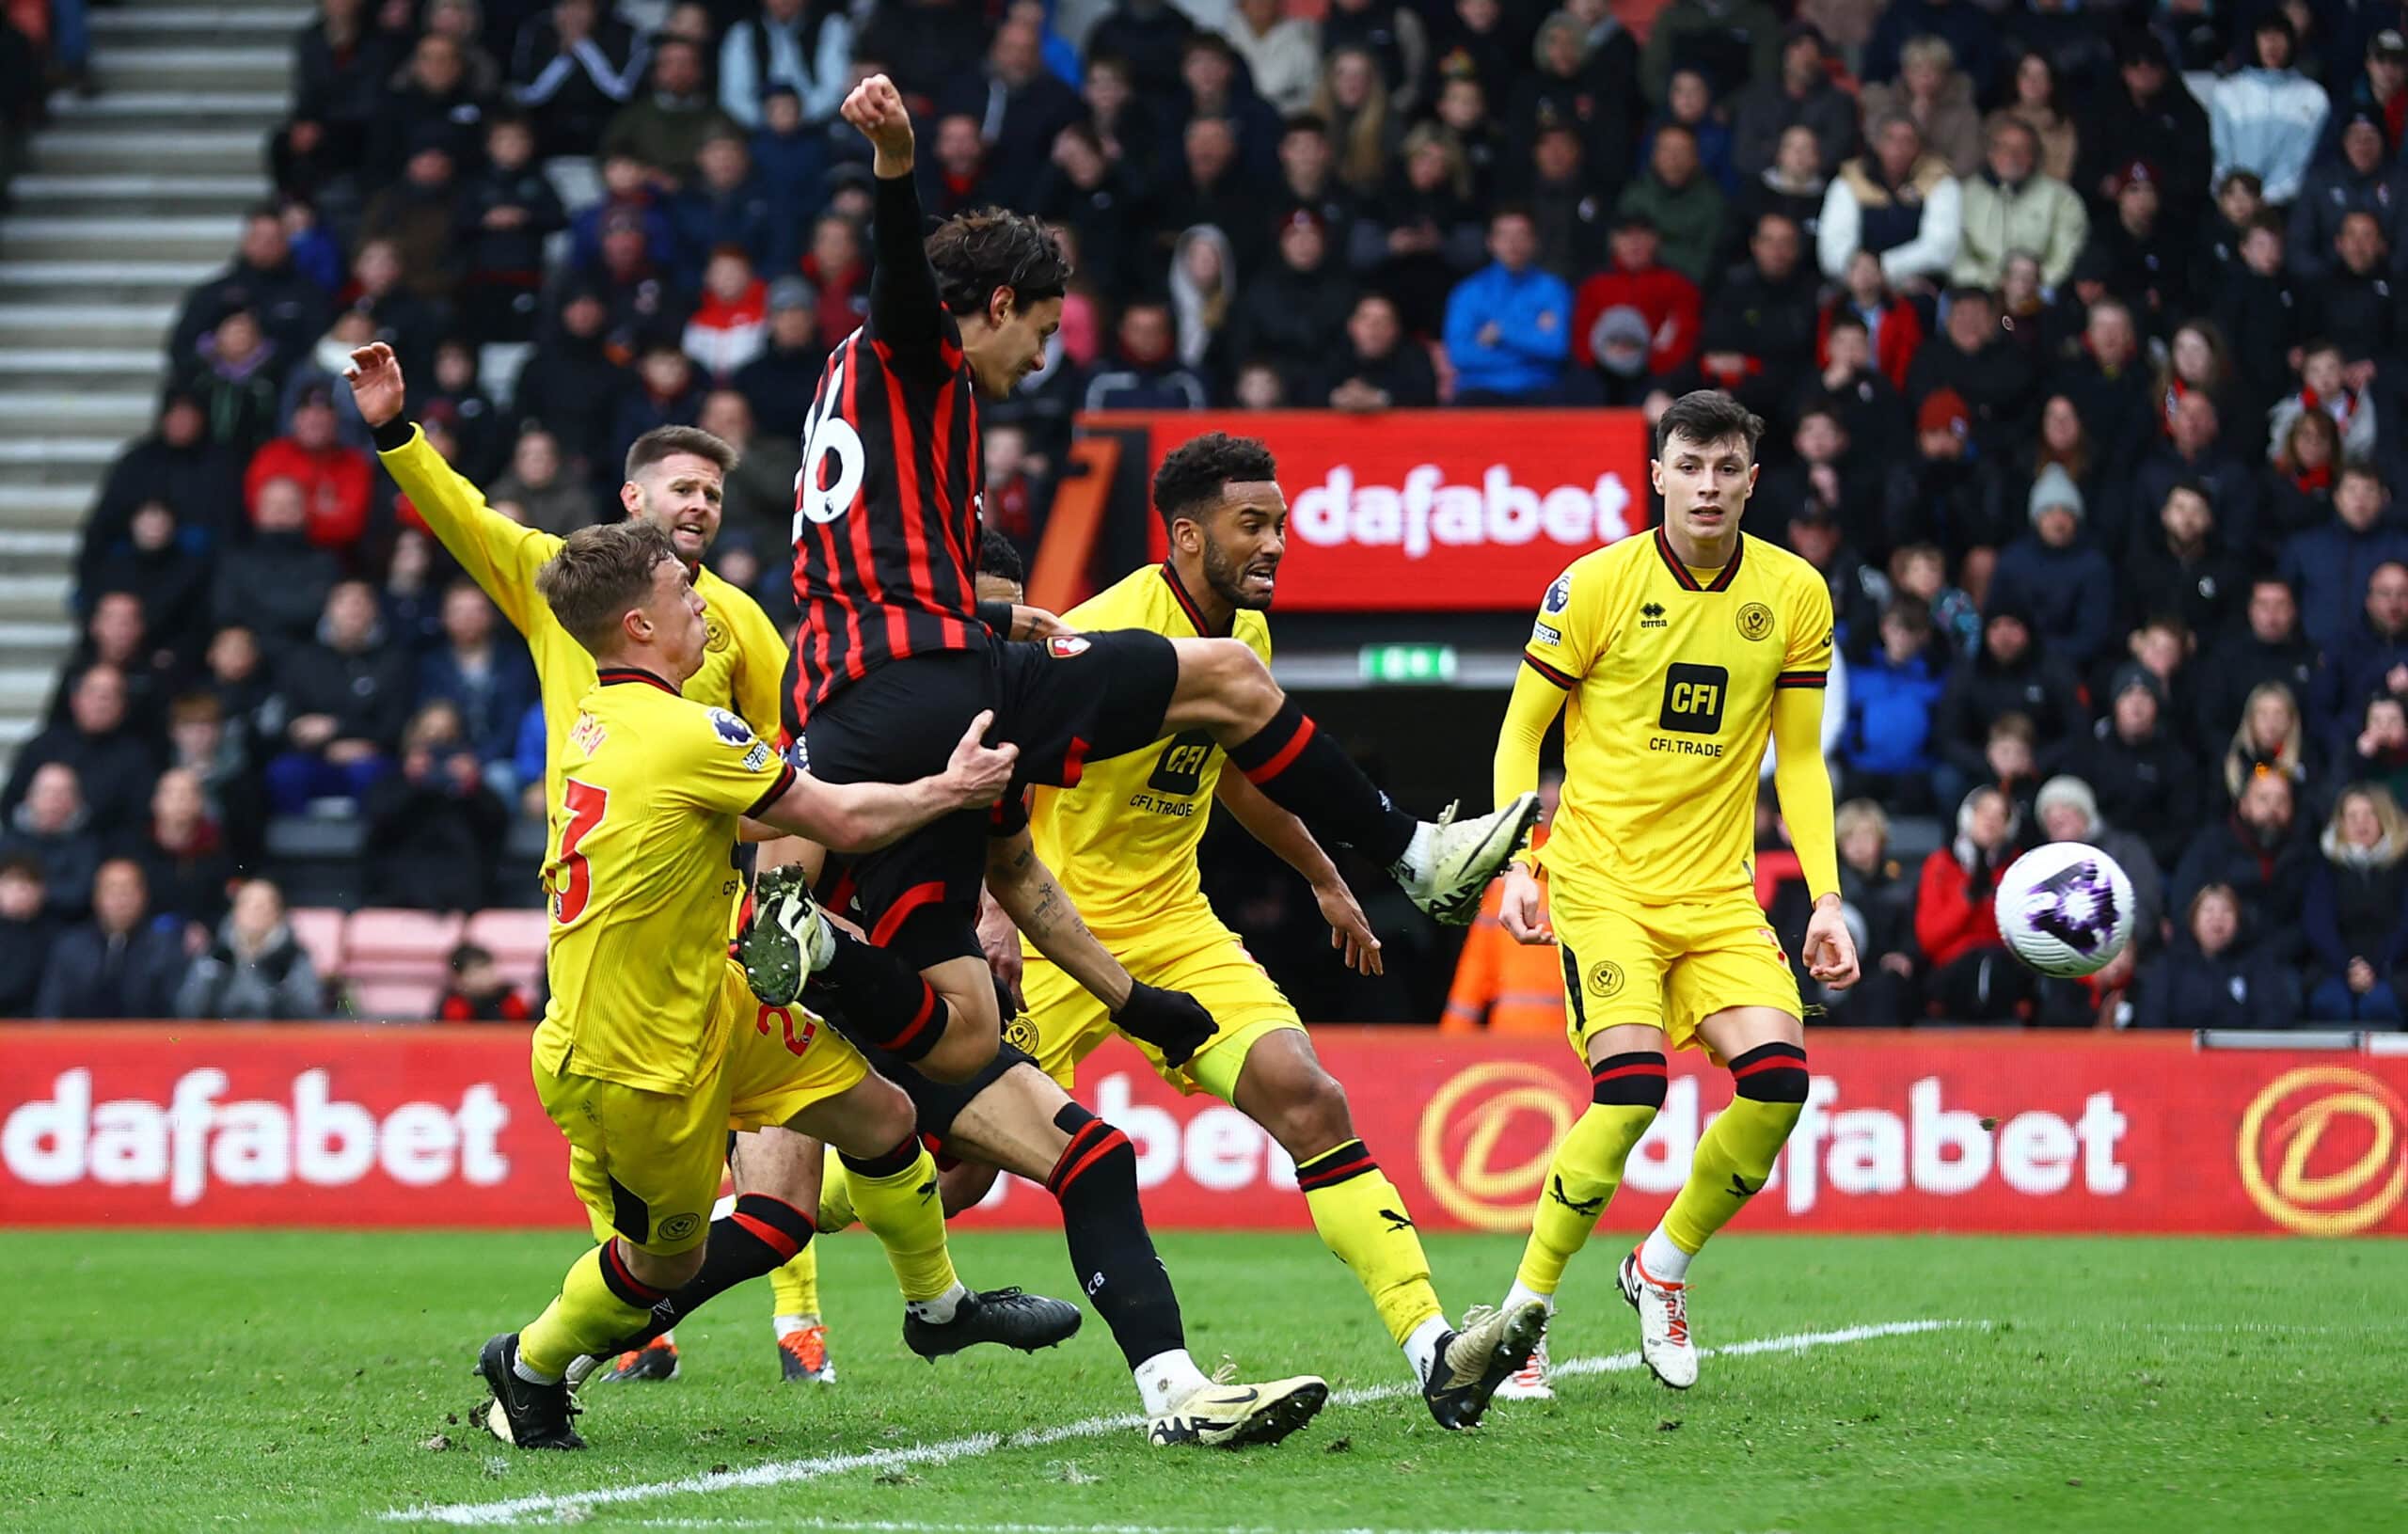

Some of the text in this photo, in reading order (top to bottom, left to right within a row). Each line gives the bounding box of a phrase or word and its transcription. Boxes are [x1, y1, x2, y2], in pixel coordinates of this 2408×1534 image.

[792, 360, 865, 536] 6
[1291, 464, 1629, 560] dafabet
[1649, 736, 1724, 758] CFI.TRADE
[1671, 682, 1719, 716] CFI
[1166, 745, 1208, 775] CFI
[2, 1066, 510, 1208] dafabet
[1624, 1073, 2128, 1215] dfabet
